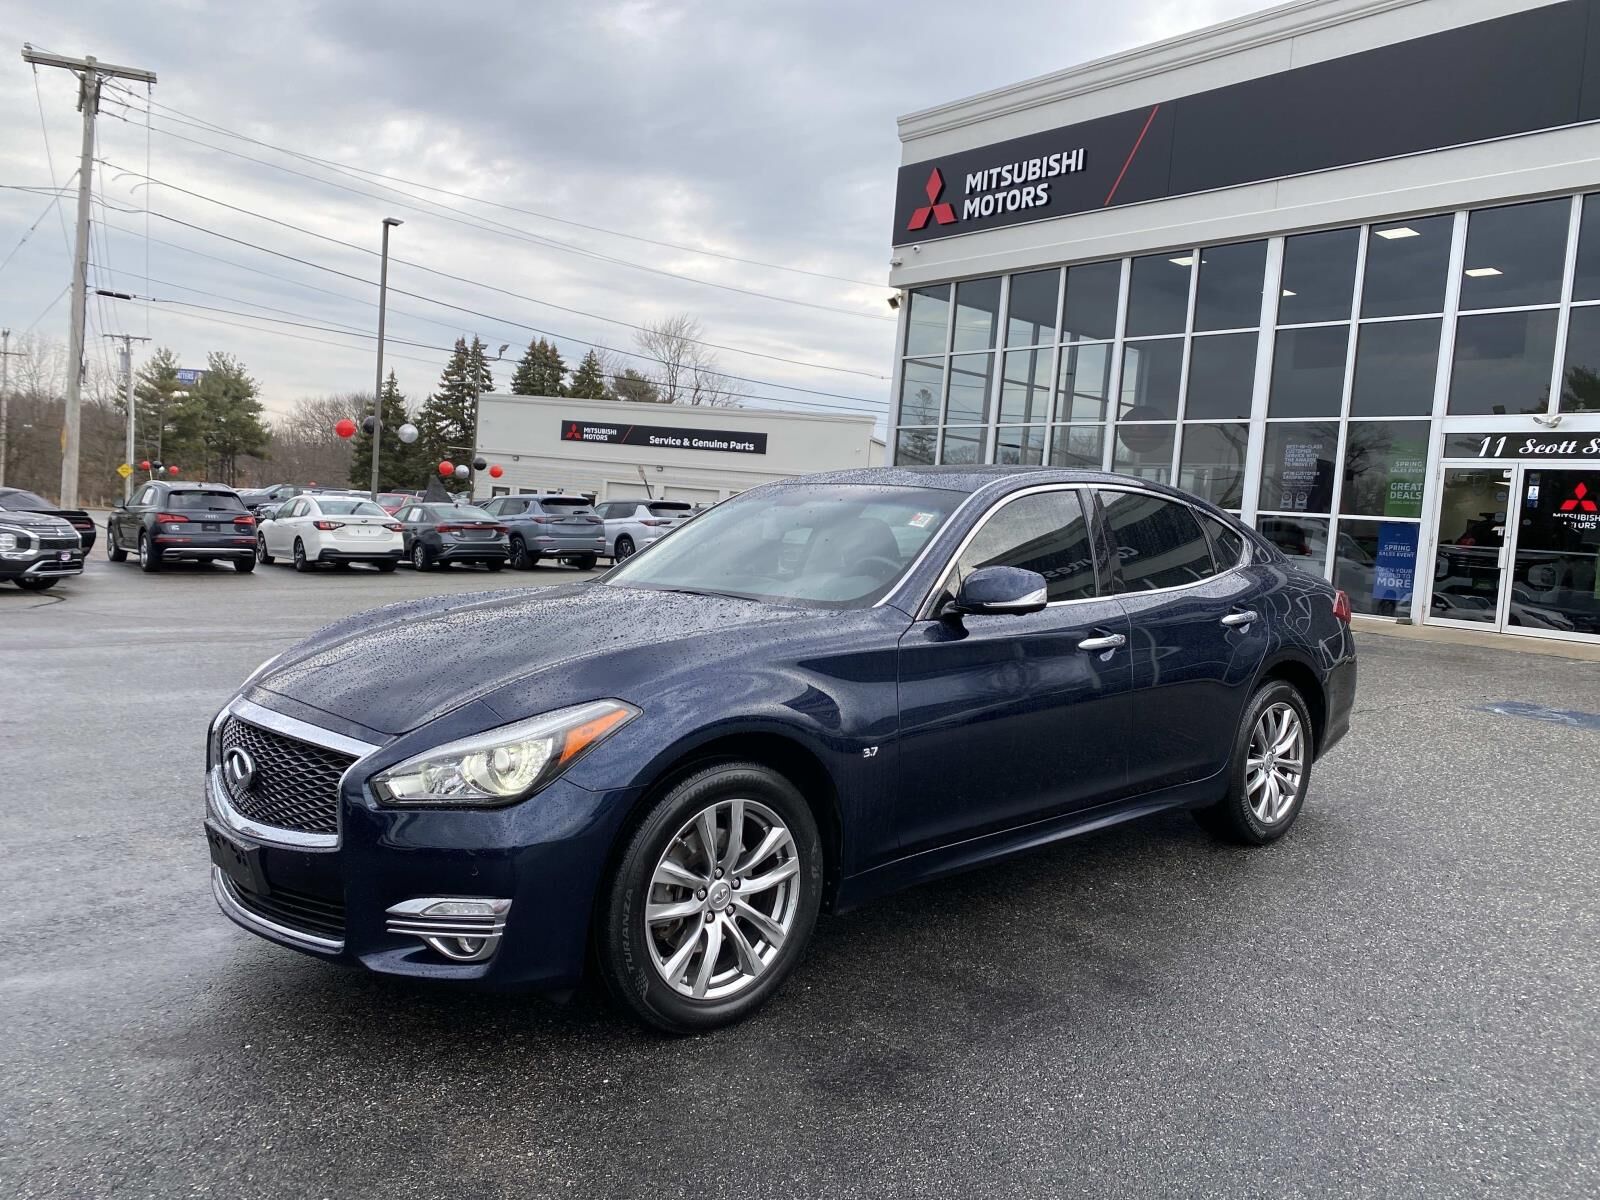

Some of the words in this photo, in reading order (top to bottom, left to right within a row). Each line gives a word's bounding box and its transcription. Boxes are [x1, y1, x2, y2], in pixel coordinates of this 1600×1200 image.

[965, 148, 1084, 194] MITSUBISHI
[962, 183, 1048, 220] MOTORS
[583, 427, 617, 435] MITSUBISHI
[649, 435, 681, 446] Service
[683, 438, 690, 446] &
[692, 438, 728, 449] Genuine
[729, 441, 755, 450] Parts
[1479, 436, 1507, 457] 11
[1519, 438, 1578, 454] Scott
[1582, 438, 1600, 454] S
[1390, 483, 1423, 491] GREAT
[1390, 491, 1422, 500] DEALS
[1377, 577, 1411, 588] MORE
[863, 746, 878, 758] 3.7
[622, 888, 635, 974] TURANZA
